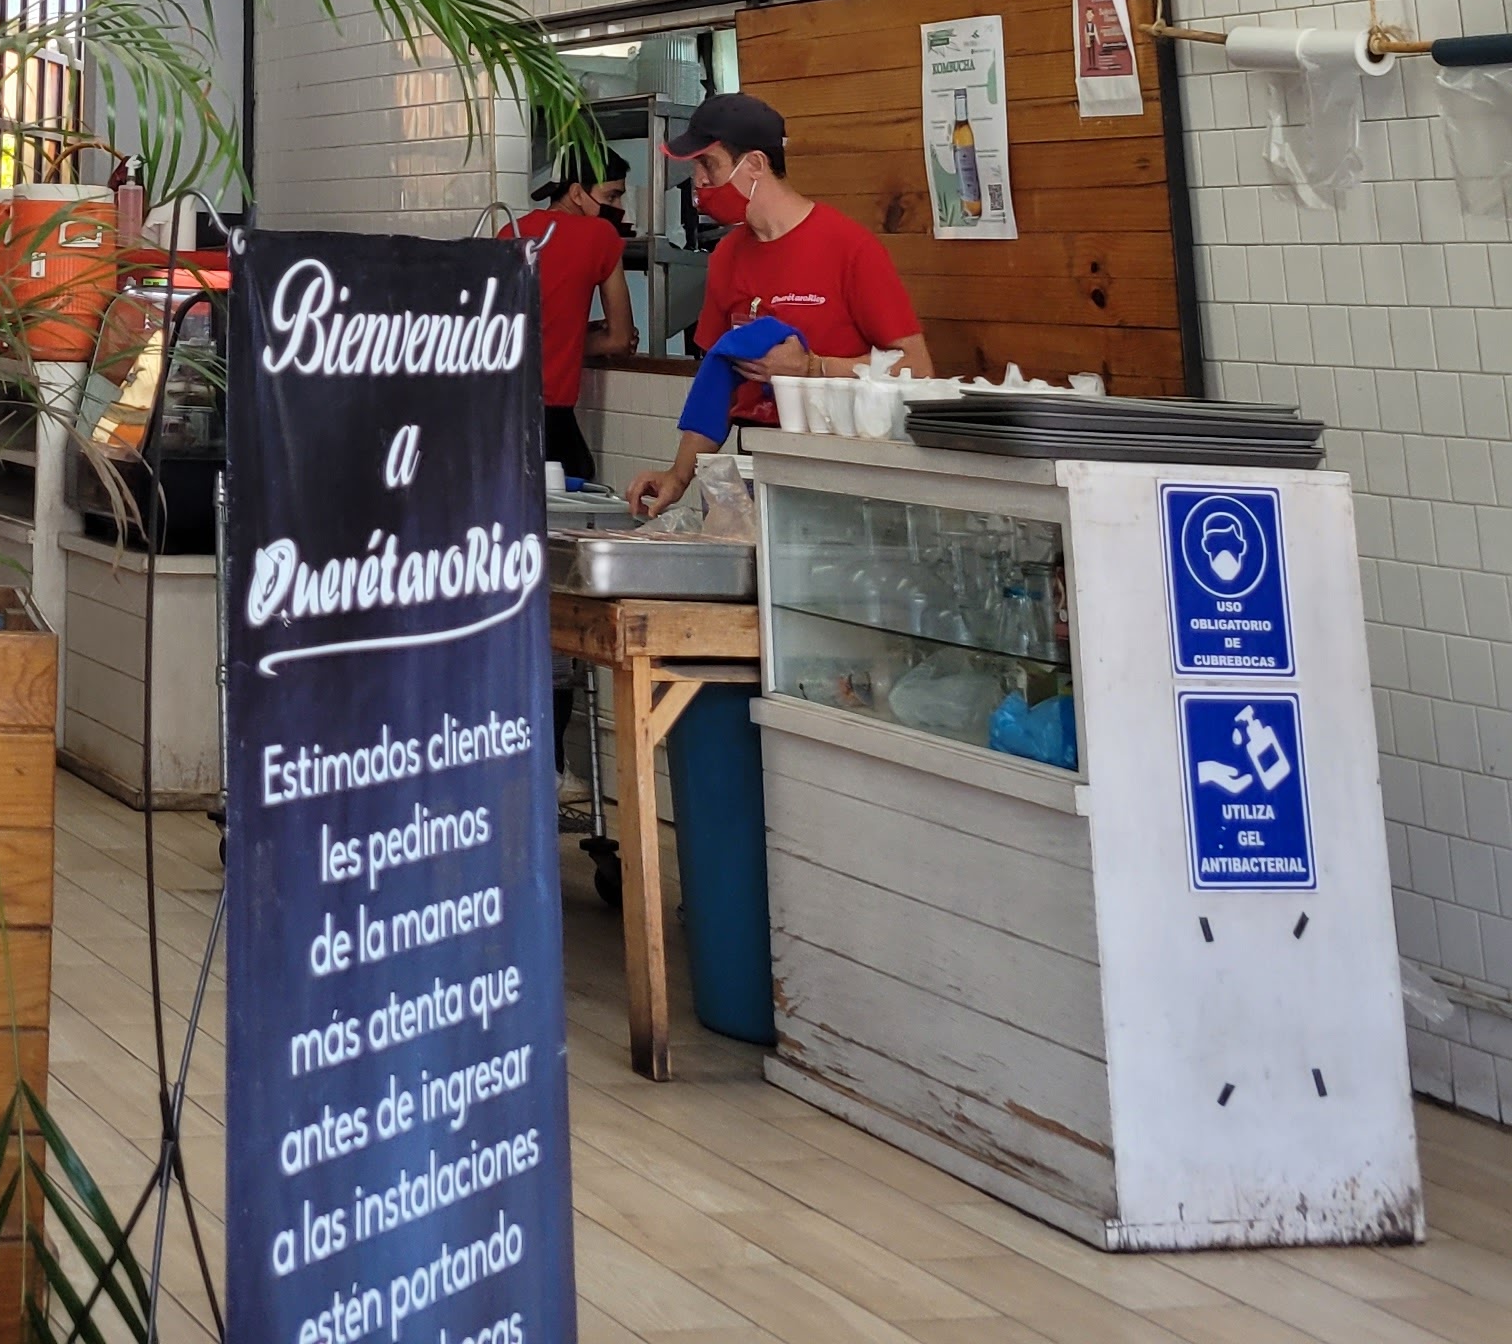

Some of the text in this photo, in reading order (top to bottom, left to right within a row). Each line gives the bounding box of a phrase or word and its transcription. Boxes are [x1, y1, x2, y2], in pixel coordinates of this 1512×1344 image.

[932, 58, 976, 75] KOMBUCHA
[262, 258, 525, 375] Bienvenidos
[383, 424, 420, 487] a
[248, 522, 542, 628] QuerétaroRico
[1216, 600, 1242, 613] USO
[1190, 618, 1272, 632] OBLIGATORIO
[1194, 654, 1275, 668] CUBREBOCAS
[1225, 637, 1241, 649] DE
[263, 713, 532, 806] Estimados clientes:
[320, 802, 489, 891] les pedimos
[1221, 804, 1276, 820] UTILIZA
[1238, 831, 1264, 847] GEL
[1201, 857, 1306, 874] ANTIBACTERIAL
[310, 886, 500, 976] de la manera
[291, 965, 521, 1075] más atenta que
[281, 1043, 531, 1175] antes de ingresar
[273, 1127, 540, 1276] a las instalaciones
[299, 1209, 524, 1344] estén portando
